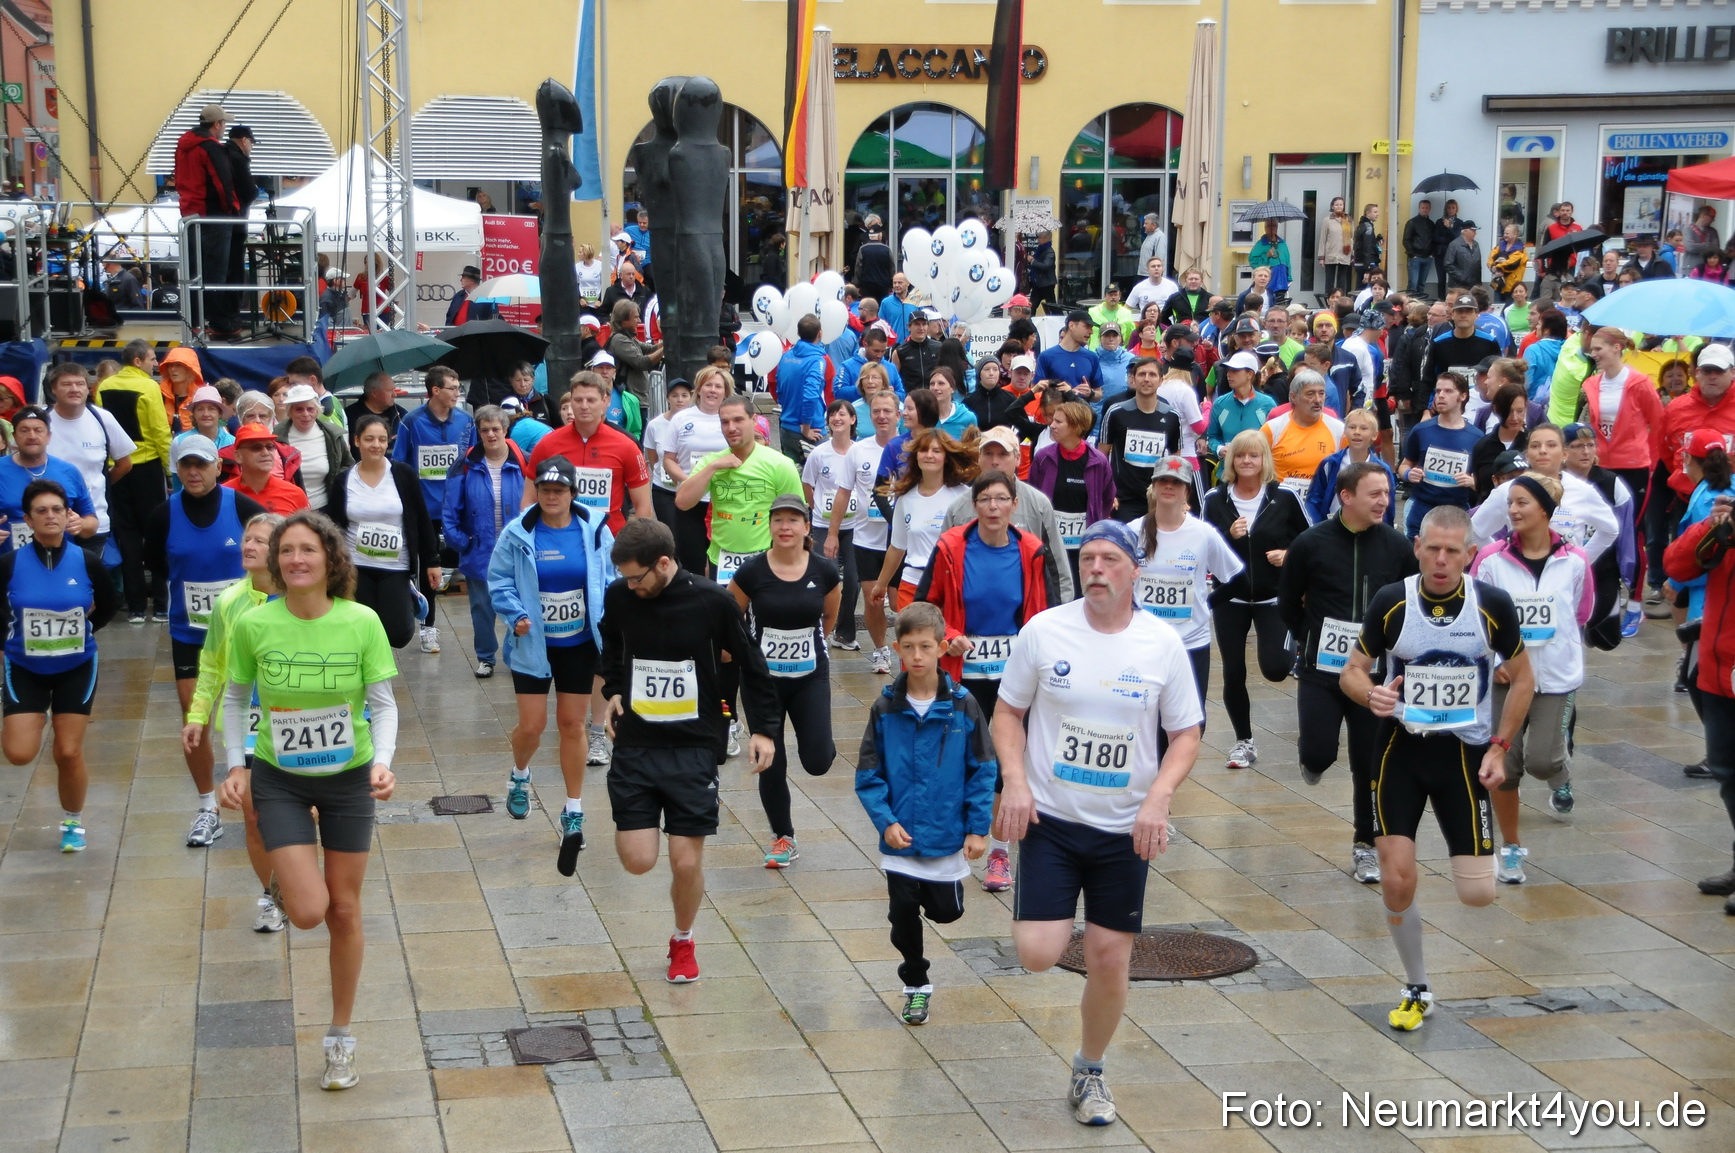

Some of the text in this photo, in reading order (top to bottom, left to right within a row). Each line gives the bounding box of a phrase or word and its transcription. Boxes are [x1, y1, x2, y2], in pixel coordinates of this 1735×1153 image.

[1614, 133, 1722, 149] BRILLEN WEBER
[1366, 167, 1382, 180] 24
[1624, 173, 1636, 181] die
[425, 232, 460, 242] BKK.
[583, 290, 597, 298] 5155
[1129, 439, 1160, 455] 3141
[423, 453, 455, 467] 5056
[1428, 457, 1463, 475] 2215
[578, 478, 607, 495] 098
[1058, 521, 1084, 536] 517
[361, 531, 398, 550] 5030
[1143, 585, 1187, 605] 2881
[1153, 608, 1177, 617] Danila
[1515, 604, 1551, 625] 029
[30, 618, 79, 637] 5173
[1323, 622, 1341, 632] PARTL
[782, 633, 806, 641] Neumarkt
[766, 640, 810, 660] 2229
[965, 638, 1012, 660] 2441
[634, 664, 655, 673] PARTL
[778, 663, 798, 673] Birgit
[980, 664, 1000, 673] Erika
[1049, 676, 1071, 686] PARTL
[1406, 671, 1465, 681] PARTL Neumarkt
[645, 675, 686, 698] 576
[1049, 682, 1071, 690] Neumarkt
[1412, 682, 1470, 707] 2132
[272, 716, 299, 726] PARTL
[300, 711, 337, 723] Neumarkt
[1432, 712, 1449, 722] ralf
[281, 720, 348, 751] 2412
[1061, 722, 1124, 741] PARTL Neumarkt
[297, 753, 337, 766] Daniela
[1062, 735, 1128, 769] 3180
[1060, 765, 1119, 787] FRANK
